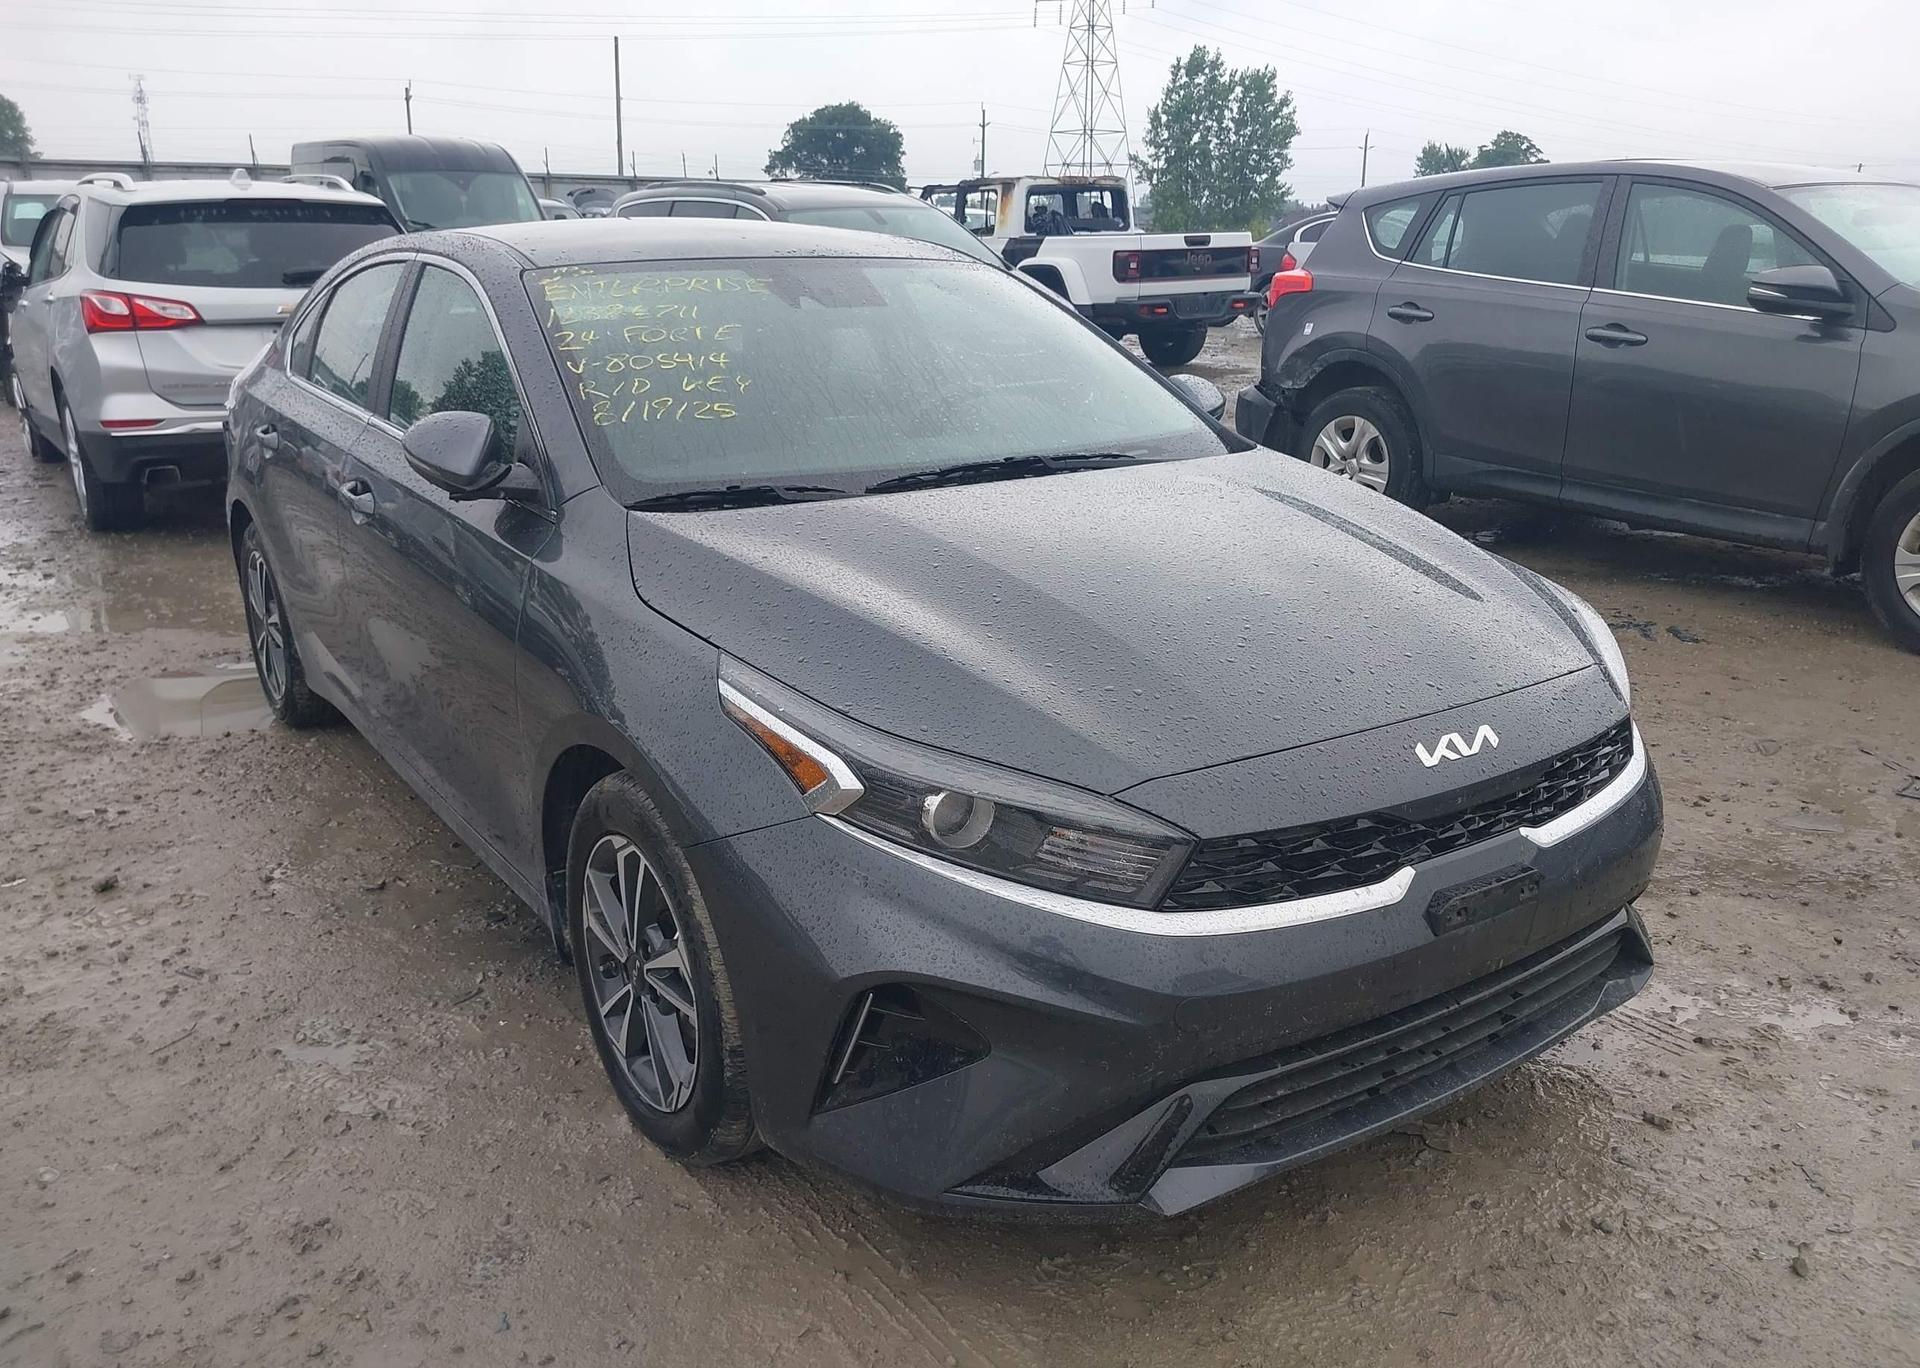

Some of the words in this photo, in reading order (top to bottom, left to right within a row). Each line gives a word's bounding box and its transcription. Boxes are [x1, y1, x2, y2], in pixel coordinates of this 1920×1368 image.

[1184, 251, 1213, 267] Jeep
[543, 276, 773, 301] ENTERPRISE
[623, 323, 742, 343] FORTE
[682, 374, 752, 395] KEY
[1415, 724, 1500, 768] KIA
